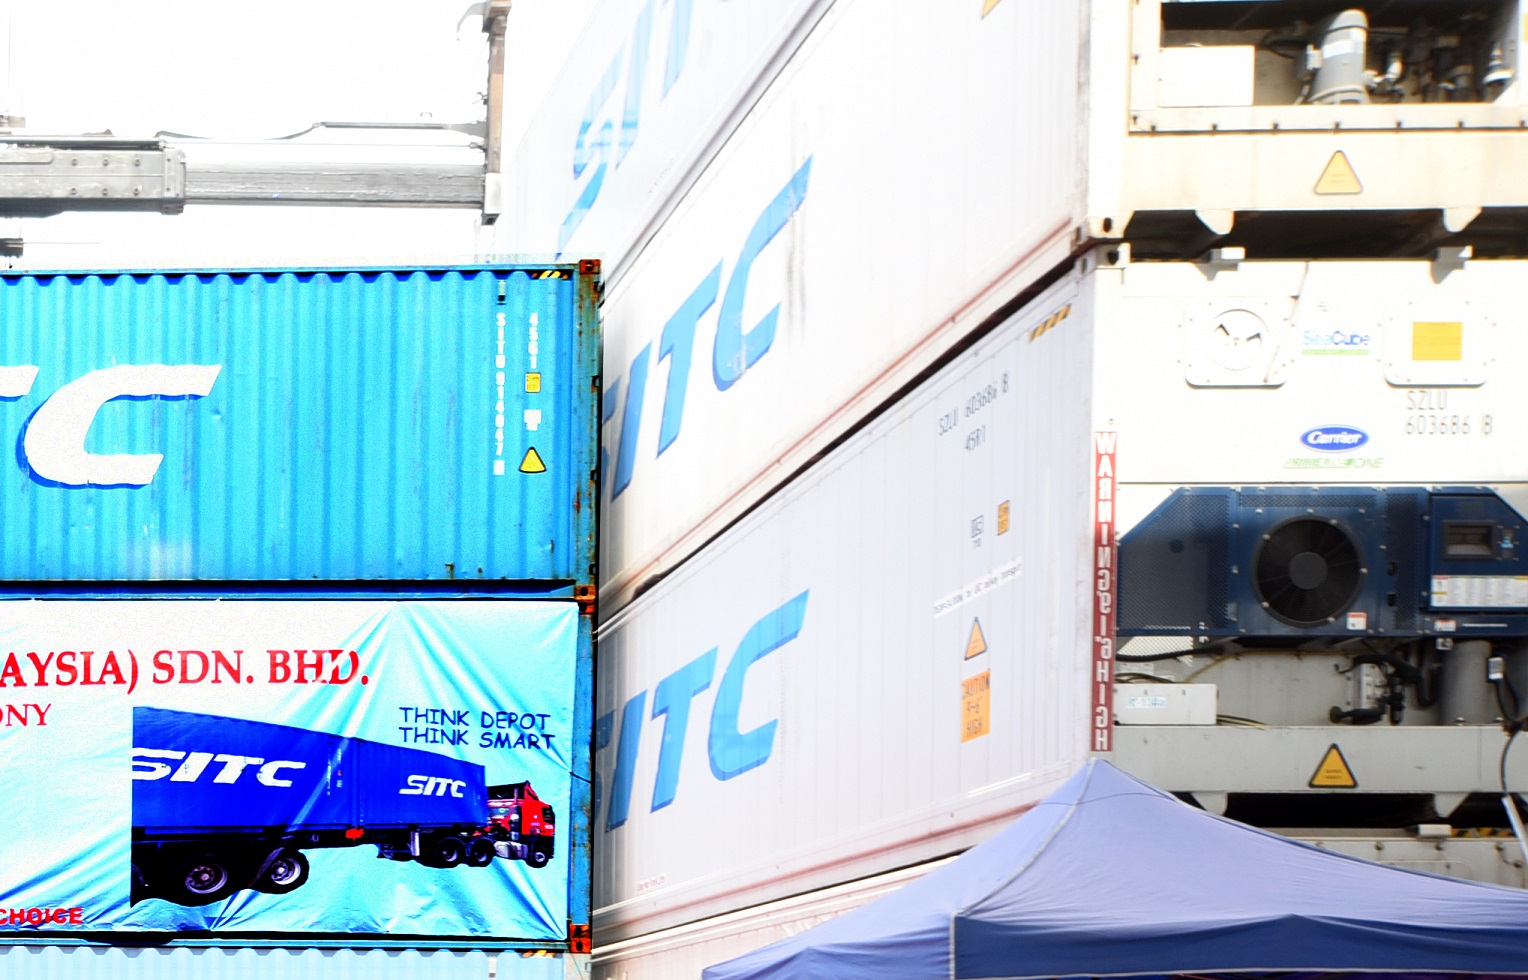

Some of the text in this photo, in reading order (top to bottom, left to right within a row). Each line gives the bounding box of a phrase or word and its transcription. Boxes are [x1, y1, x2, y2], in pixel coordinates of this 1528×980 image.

[601, 153, 814, 503] ITC
[1406, 390, 1448, 411] SZLU
[1405, 414, 1471, 435] 603686
[1306, 430, 1363, 446] Carrier
[152, 649, 255, 685] SDN.
[267, 649, 369, 686] BHD.
[398, 706, 552, 731] THINK DEPOT
[595, 588, 810, 833] ITC
[398, 726, 556, 750] THINK SMART
[132, 747, 307, 788] SITC
[399, 774, 467, 798] SITC
